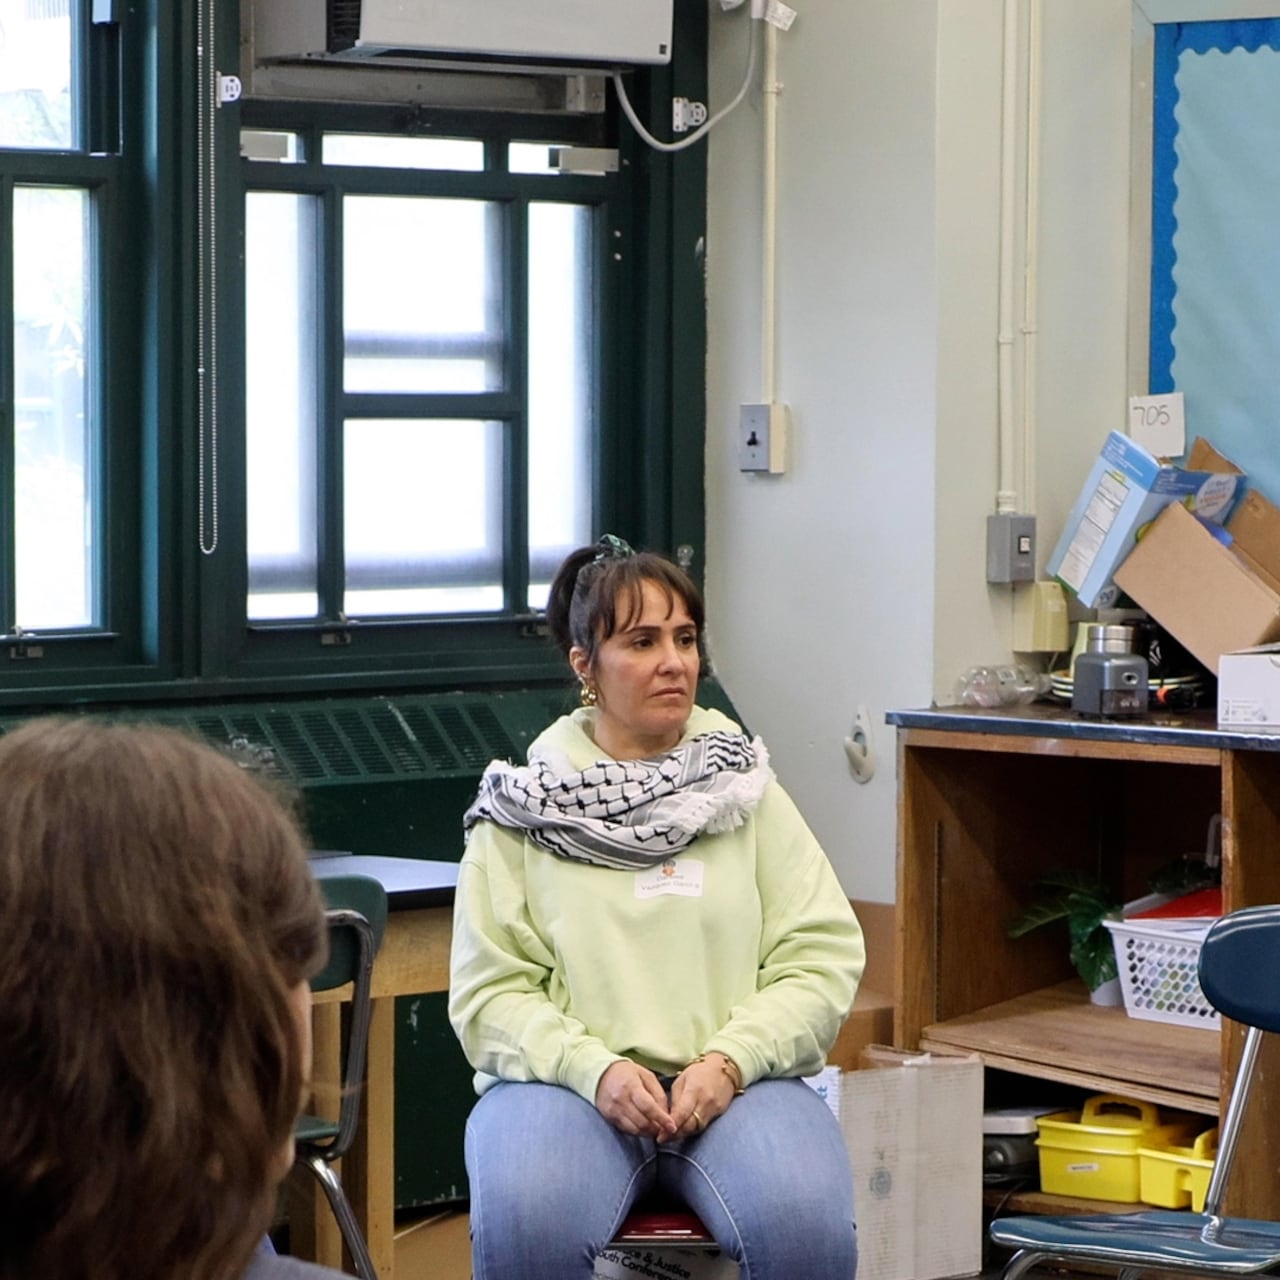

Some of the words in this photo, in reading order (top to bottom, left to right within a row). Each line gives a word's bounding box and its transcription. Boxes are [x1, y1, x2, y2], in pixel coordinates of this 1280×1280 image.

[1132, 404, 1170, 426] 705
[597, 1248, 620, 1266] outh
[654, 1256, 691, 1279] Justice
